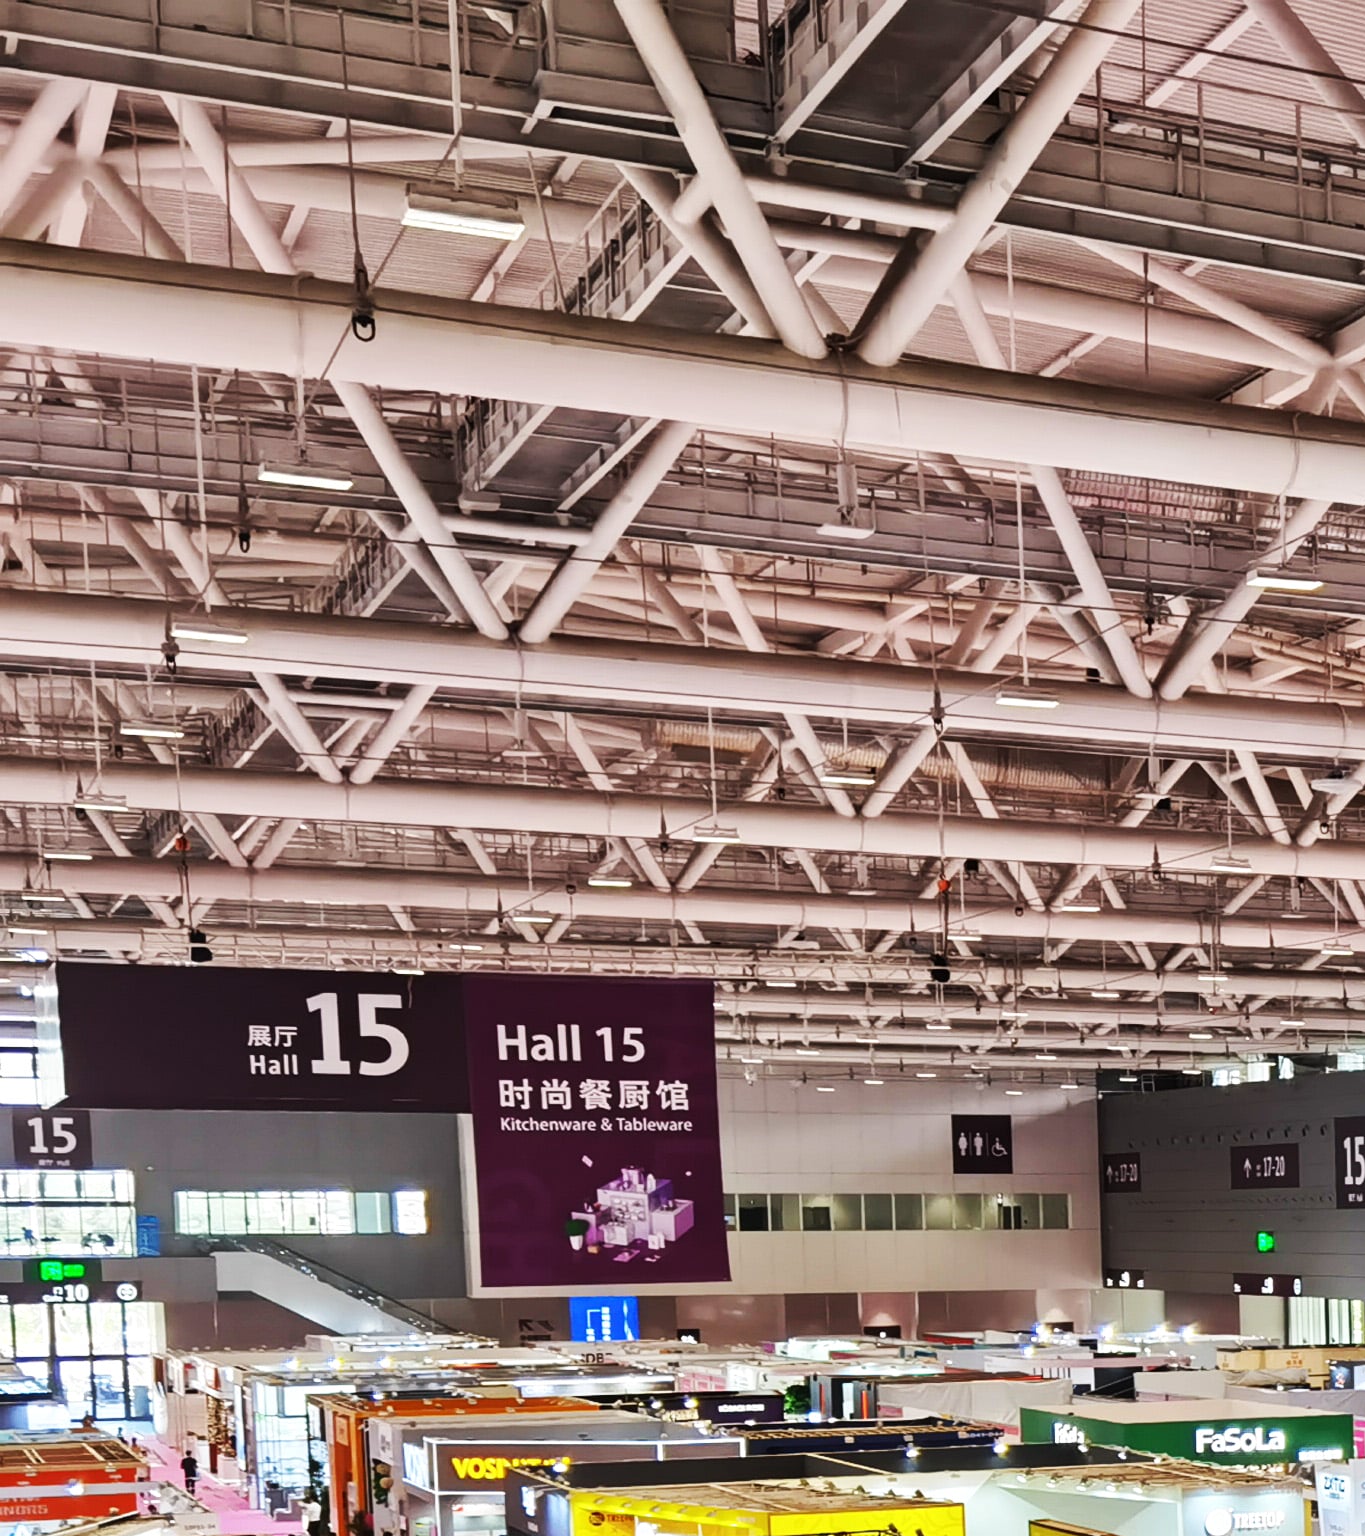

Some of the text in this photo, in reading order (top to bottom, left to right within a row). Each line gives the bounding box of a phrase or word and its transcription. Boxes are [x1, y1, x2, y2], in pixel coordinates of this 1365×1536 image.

[247, 1026, 298, 1048] 展厅
[306, 992, 410, 1077] 15
[497, 1025, 646, 1063] Hall 15
[249, 1054, 299, 1077] Hall
[498, 1079, 691, 1112] 时尚餐厨馆
[27, 1117, 78, 1155] 15
[500, 1116, 693, 1133] Kitchenware & Tableware
[1263, 1156, 1286, 1178] 17-20
[64, 1285, 89, 1301] 10
[1195, 1427, 1286, 1454] FaSoLa
